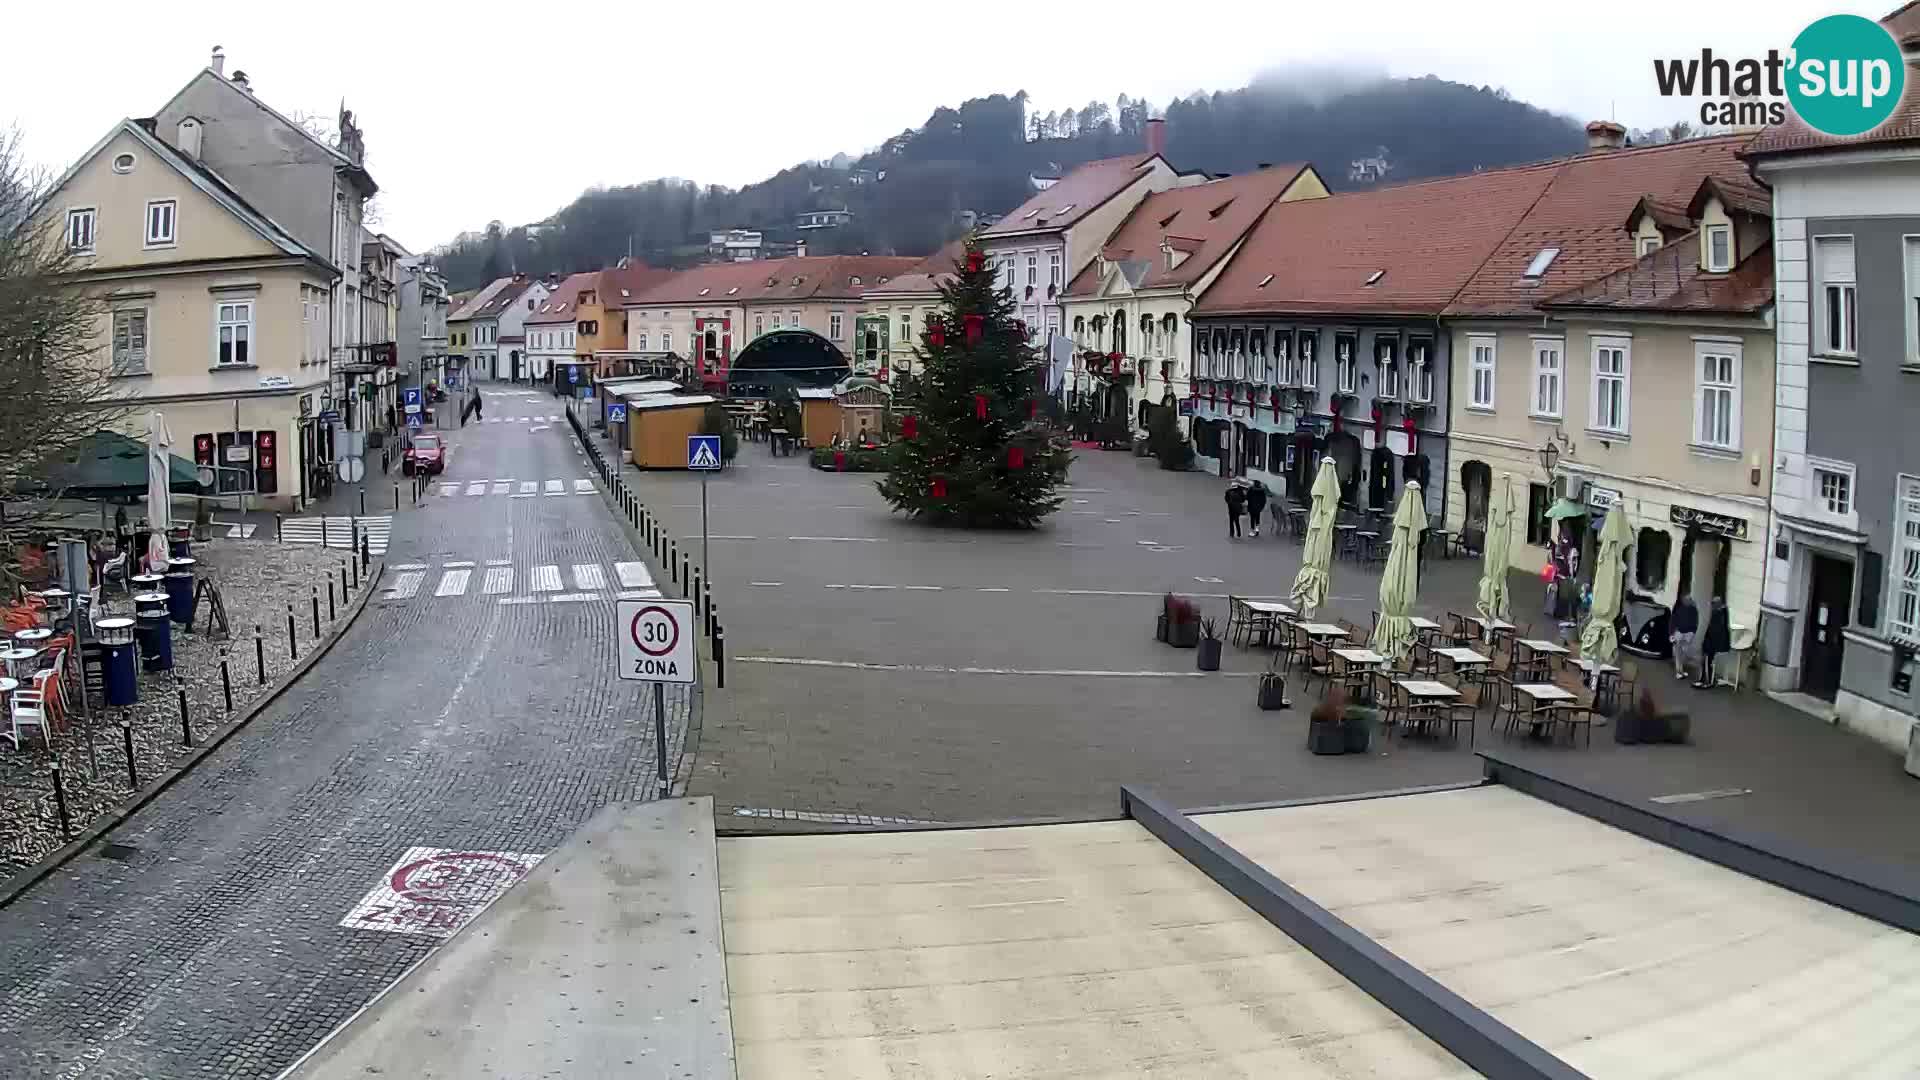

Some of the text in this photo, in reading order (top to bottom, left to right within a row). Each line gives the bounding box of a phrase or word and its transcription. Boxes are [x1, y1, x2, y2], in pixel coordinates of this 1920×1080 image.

[408, 391, 417, 402] P
[643, 622, 668, 643] 30
[634, 659, 679, 676] ZONA
